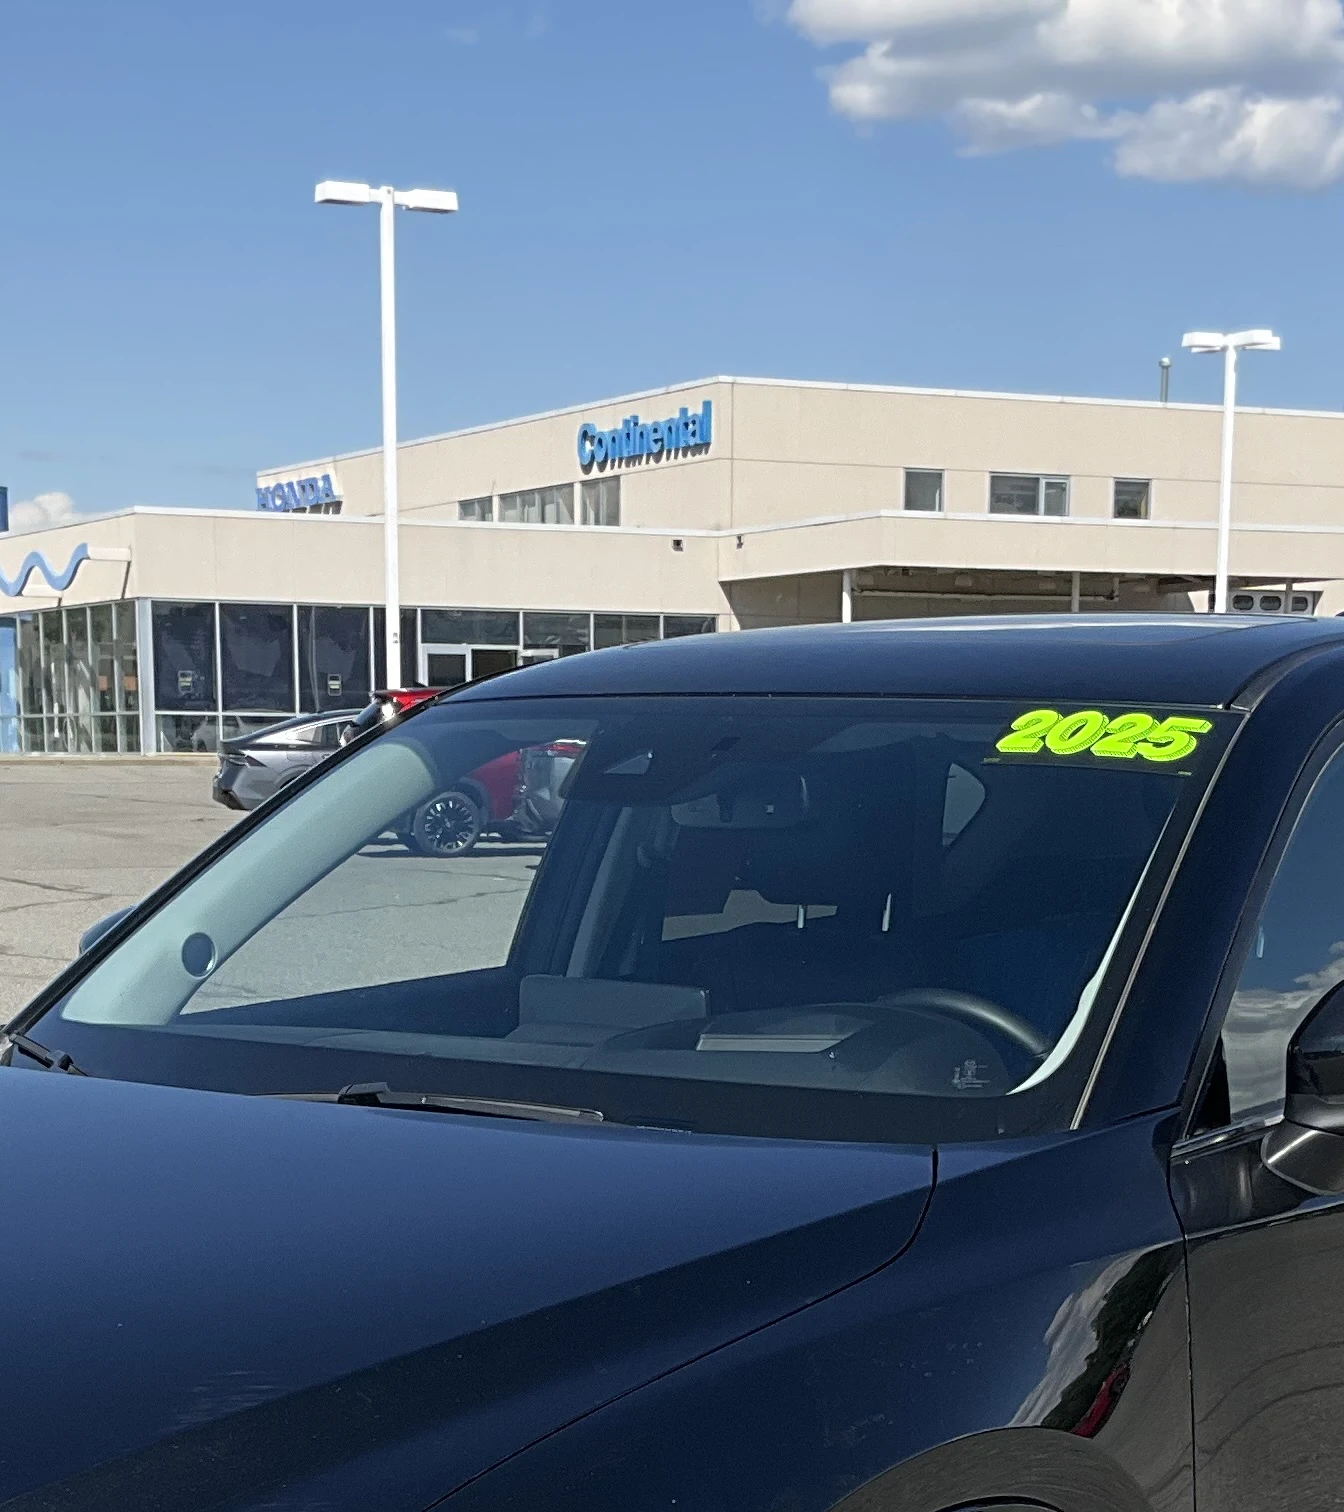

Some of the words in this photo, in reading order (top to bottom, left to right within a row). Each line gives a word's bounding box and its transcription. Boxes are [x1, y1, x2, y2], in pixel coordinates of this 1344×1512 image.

[577, 399, 712, 466] Continental
[255, 474, 335, 512] HONDA
[995, 709, 1212, 761] 2025
